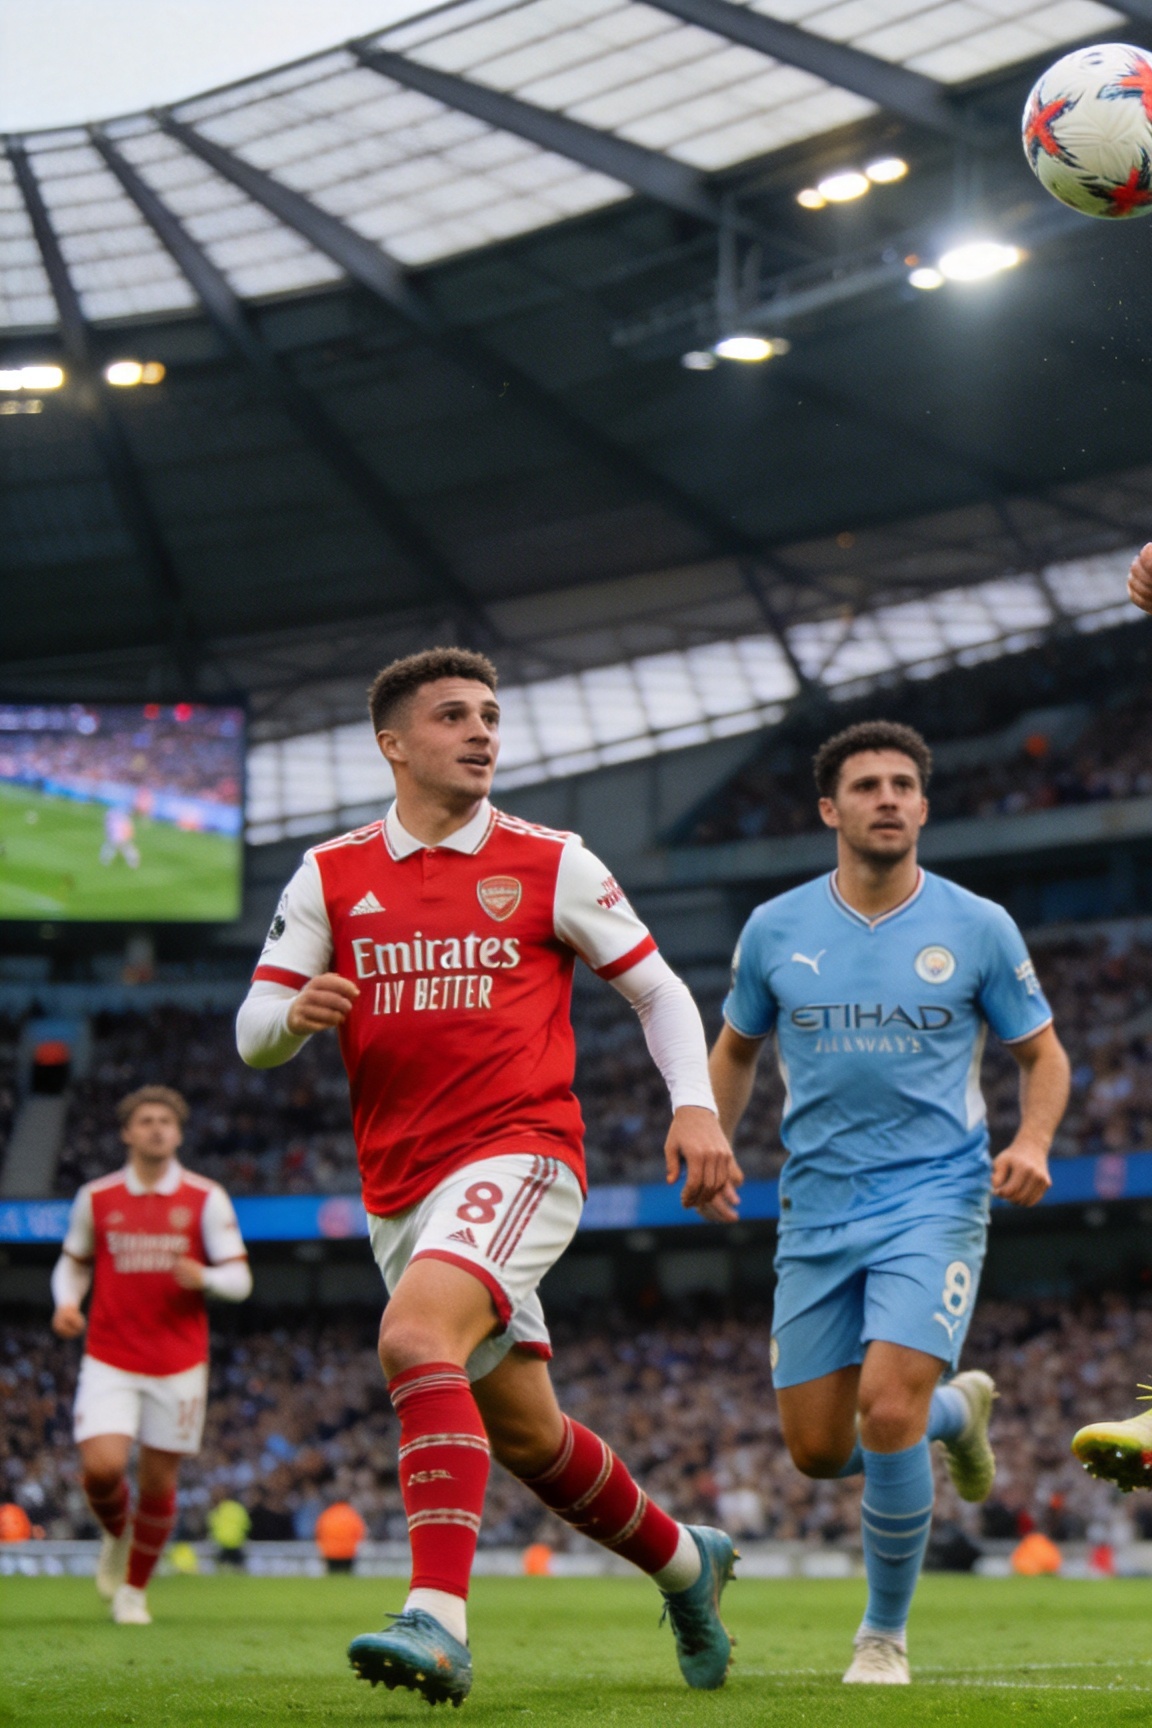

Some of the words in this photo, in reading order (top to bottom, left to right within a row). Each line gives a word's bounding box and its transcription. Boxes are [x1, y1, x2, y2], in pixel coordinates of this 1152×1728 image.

[352, 931, 521, 979] Emirates
[414, 974, 493, 1011] BETTER
[791, 1003, 953, 1030] ETIHAD
[456, 1181, 503, 1224] 8
[942, 1261, 971, 1317] 8
